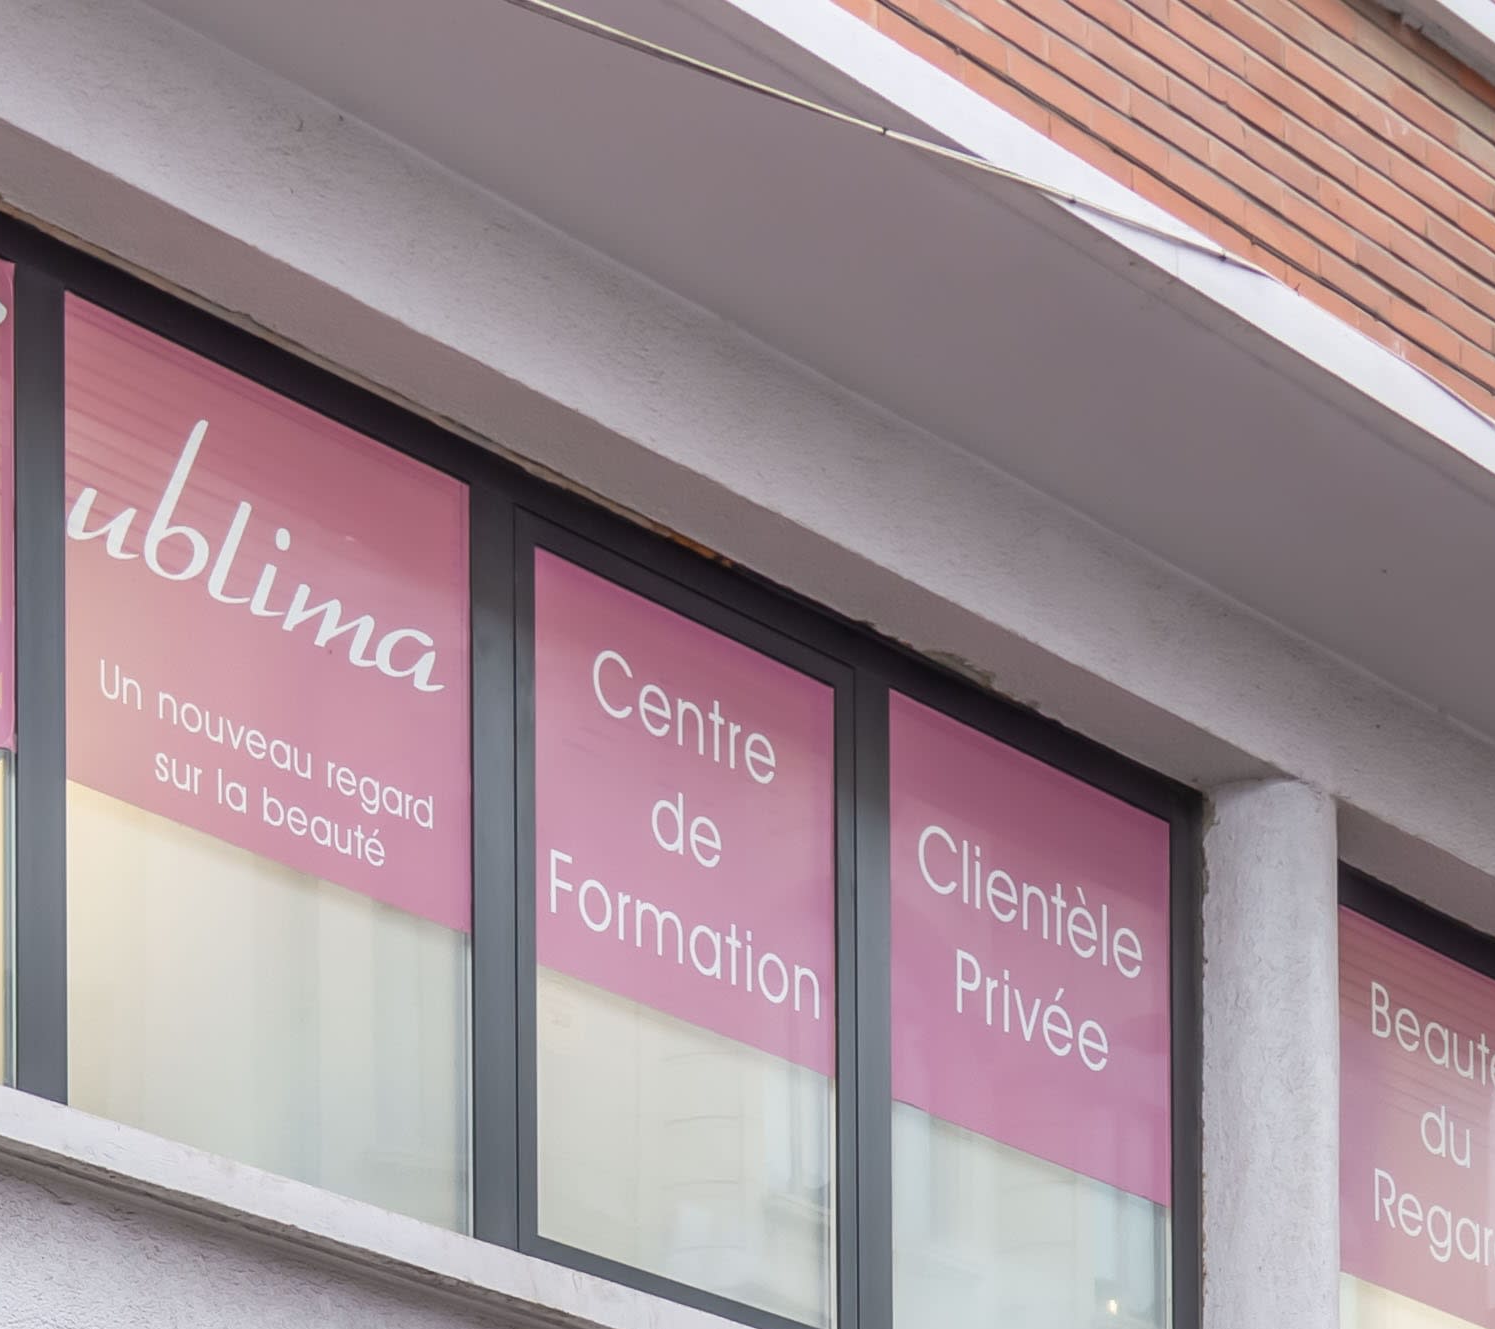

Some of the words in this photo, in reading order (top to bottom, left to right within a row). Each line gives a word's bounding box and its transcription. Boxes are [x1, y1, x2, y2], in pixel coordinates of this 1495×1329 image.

[99, 659, 142, 712] Un
[160, 690, 312, 778] nouveau
[327, 757, 435, 832] regard
[592, 650, 777, 785] Centre
[154, 751, 203, 798] sur
[217, 766, 247, 813] la
[262, 795, 386, 868] beauté
[651, 792, 722, 868] de
[549, 848, 821, 1020] Formation
[918, 826, 1143, 979] Clientèle
[956, 950, 1109, 1072] Privée
[1420, 1106, 1471, 1169] du
